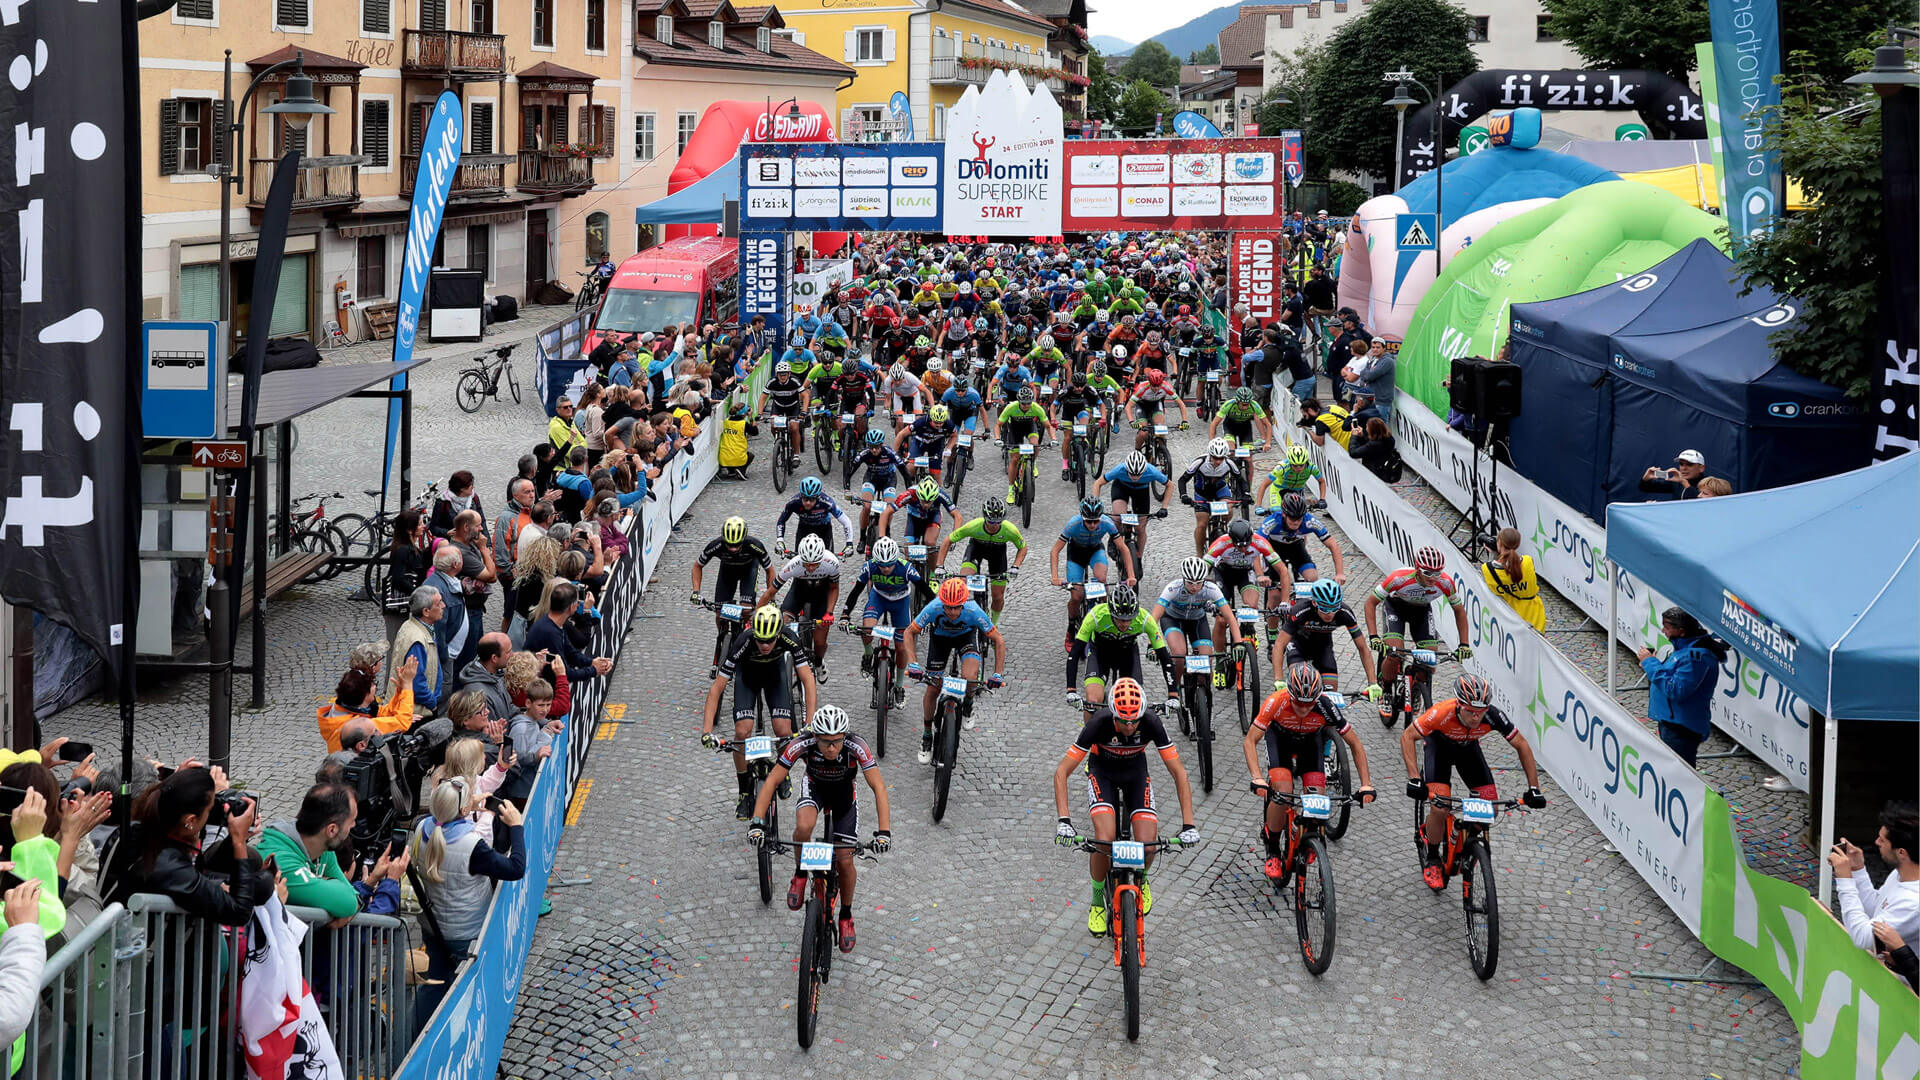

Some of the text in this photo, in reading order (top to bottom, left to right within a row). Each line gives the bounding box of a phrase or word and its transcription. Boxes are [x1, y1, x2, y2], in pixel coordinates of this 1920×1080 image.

[346, 40, 394, 67] Hotel
[1500, 74, 1634, 106] fi'zi:k
[1014, 141, 1038, 151] EDITION
[1039, 139, 1054, 147] 2018
[958, 158, 1048, 180] Dolomiti
[896, 197, 931, 206] KASK
[958, 183, 1048, 200] SUPERBIKE
[1135, 197, 1164, 205] CONAD
[1230, 195, 1259, 203] ERDINGER
[407, 117, 458, 294] Marlene
[752, 198, 789, 209] fi'zi:k
[980, 206, 1023, 219] START
[745, 239, 757, 313] EXPLORE THE
[758, 239, 777, 313] LEGEND
[1239, 239, 1252, 303] PLORE THE
[1252, 239, 1273, 318] LEGEND
[1396, 407, 1442, 471] CANYON
[1353, 485, 1415, 568] CANYON
[870, 573, 905, 586] BIKE
[1496, 580, 1528, 595] CREW
[1722, 597, 1797, 662] MASTERTENT
[1720, 614, 1796, 676] building up moments
[746, 740, 766, 752] 5021
[1723, 709, 1808, 776] NEXT ENERG
[1557, 690, 1689, 847] sorgenia
[1304, 798, 1325, 808] 5002
[1464, 801, 1487, 813] 5006
[1571, 771, 1688, 901] YOUR NEXT ENERGY
[802, 847, 824, 860] 5009
[1113, 846, 1137, 860] 5018
